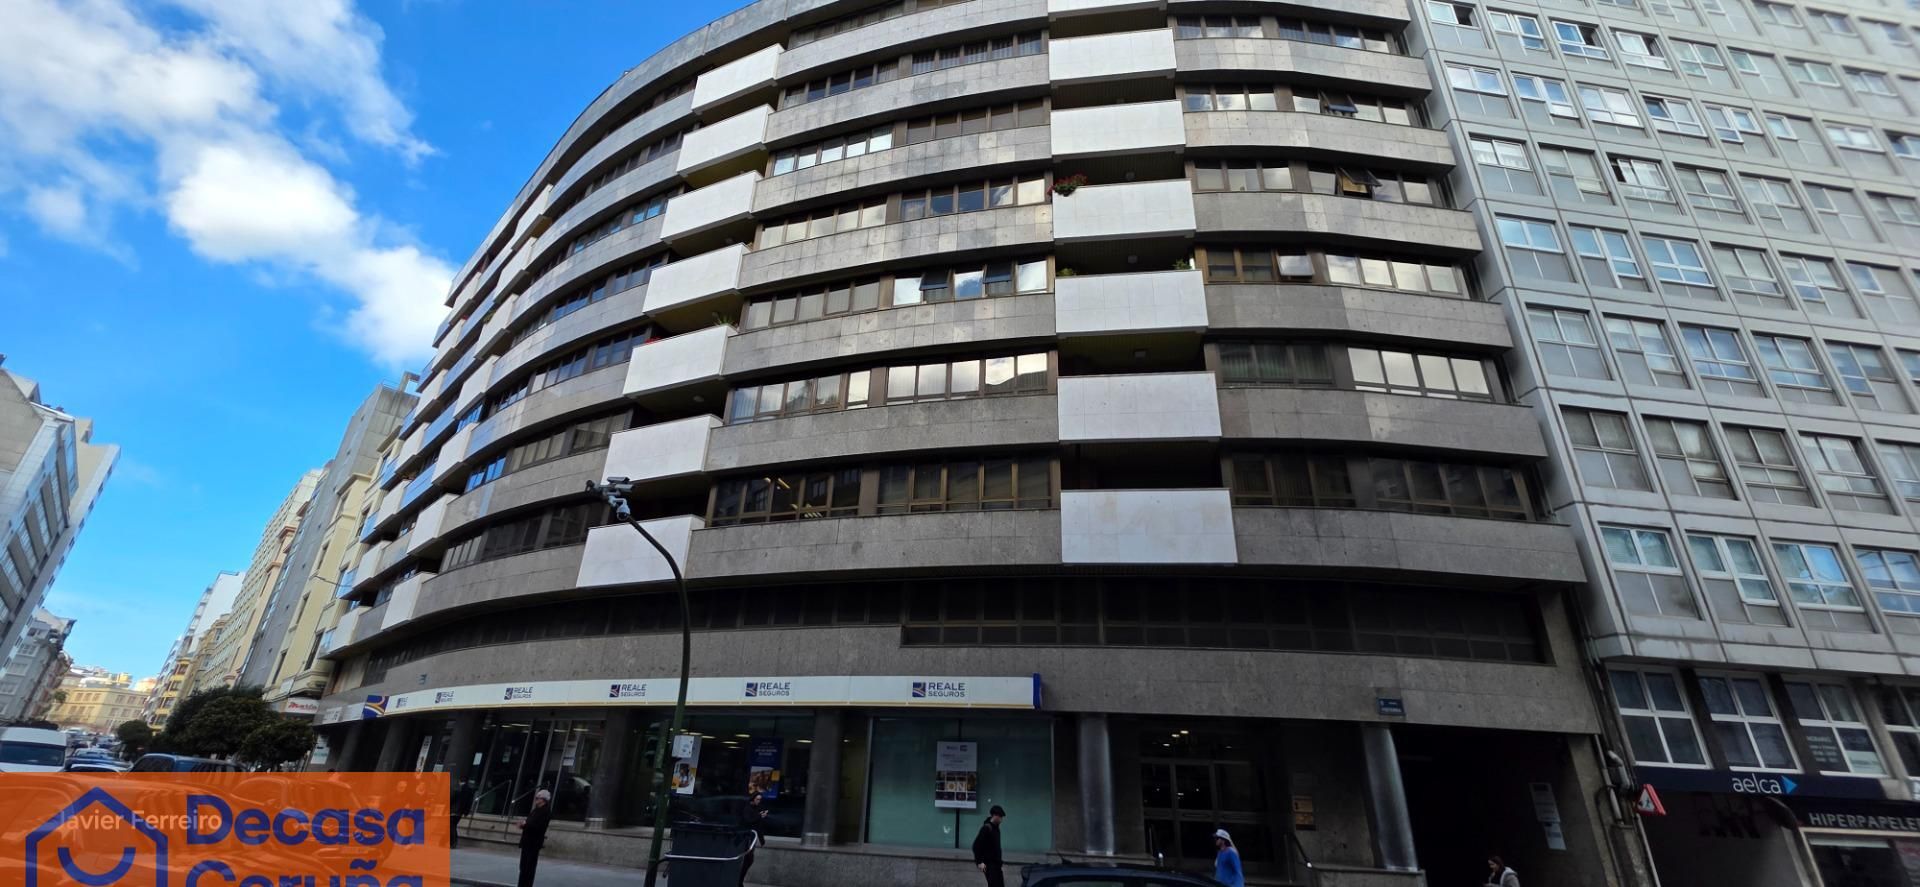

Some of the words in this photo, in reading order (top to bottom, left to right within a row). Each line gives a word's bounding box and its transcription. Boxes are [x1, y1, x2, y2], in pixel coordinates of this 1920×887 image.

[760, 682, 791, 690] REALE
[928, 682, 966, 691] REALE
[927, 690, 966, 698] SEGUROS
[1731, 773, 1782, 794] aelca
